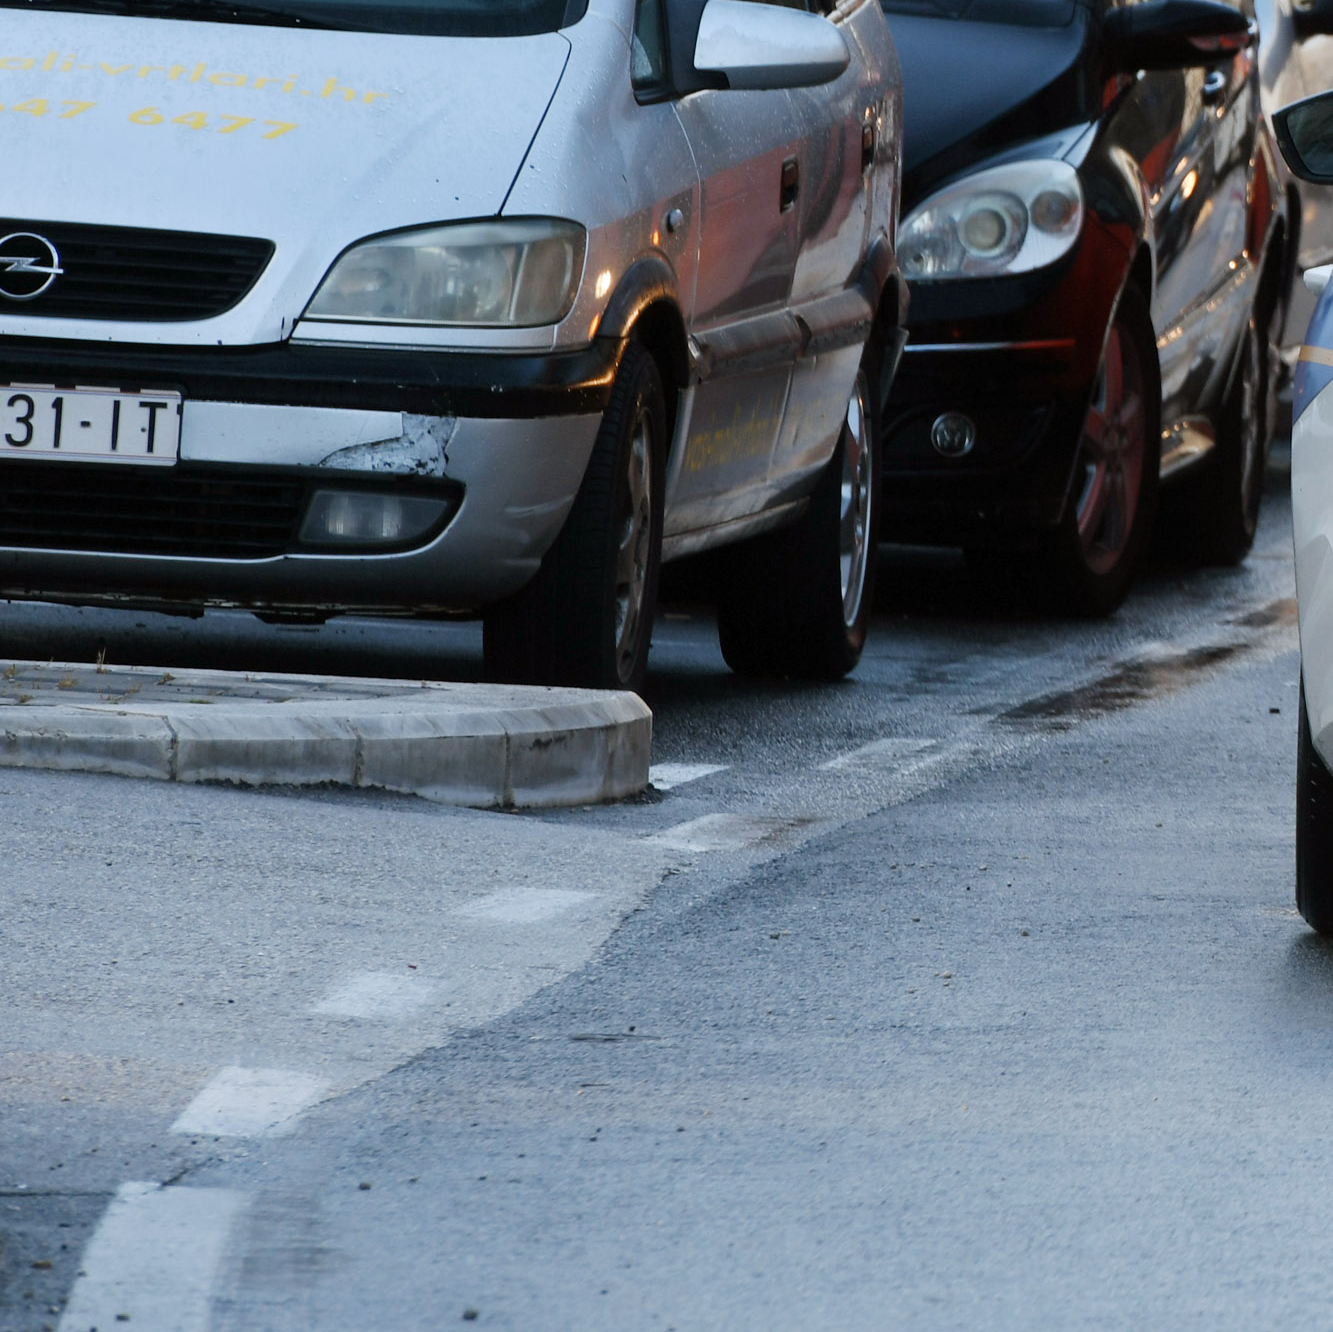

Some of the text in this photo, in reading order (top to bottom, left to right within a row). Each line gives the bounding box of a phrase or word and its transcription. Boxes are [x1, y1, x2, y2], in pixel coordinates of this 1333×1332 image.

[0, 98, 300, 141] 47 6477
[5, 393, 168, 453] 31-IT
